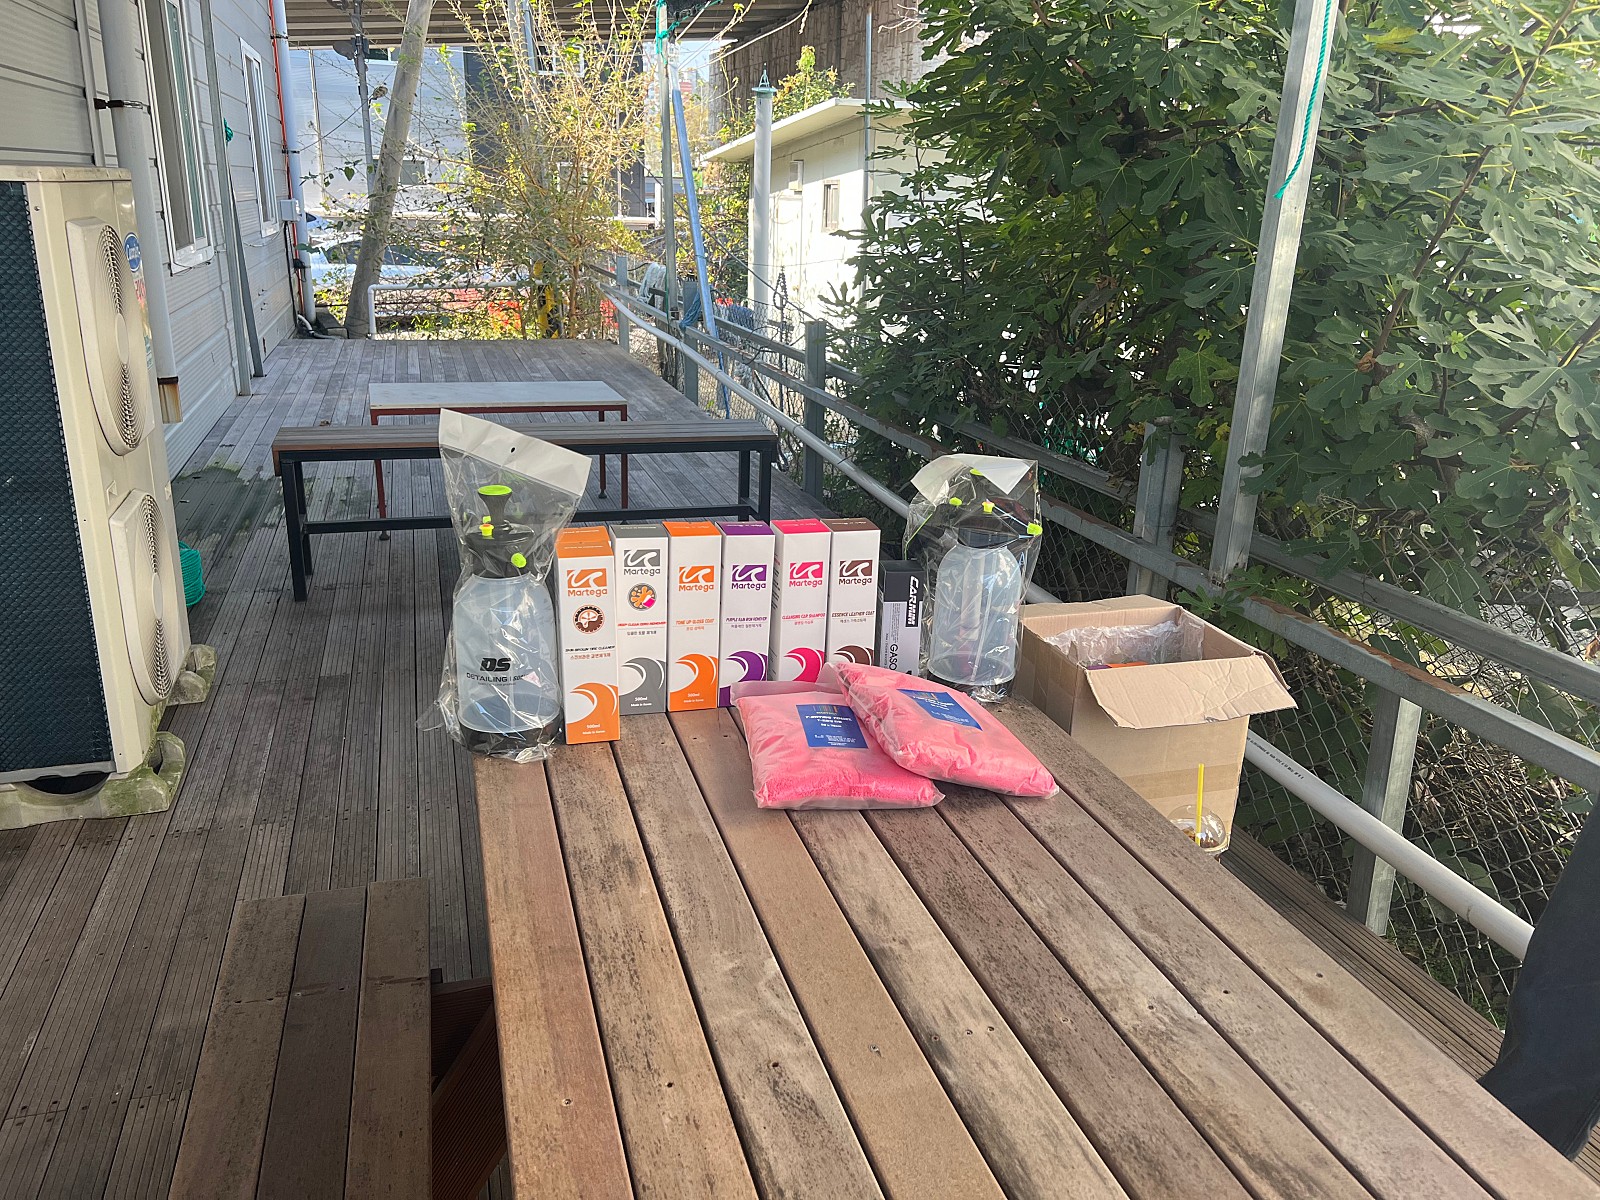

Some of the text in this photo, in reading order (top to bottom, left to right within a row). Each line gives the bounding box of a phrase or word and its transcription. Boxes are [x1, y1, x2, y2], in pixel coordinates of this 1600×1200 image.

[624, 568, 661, 577] Martega
[789, 579, 823, 588] Martega
[839, 577, 873, 586] Martega
[678, 584, 715, 593] Martega
[731, 582, 767, 591] Martega
[567, 588, 608, 598] Martega
[480, 657, 512, 672] DS
[466, 672, 508, 683] DETAILING
